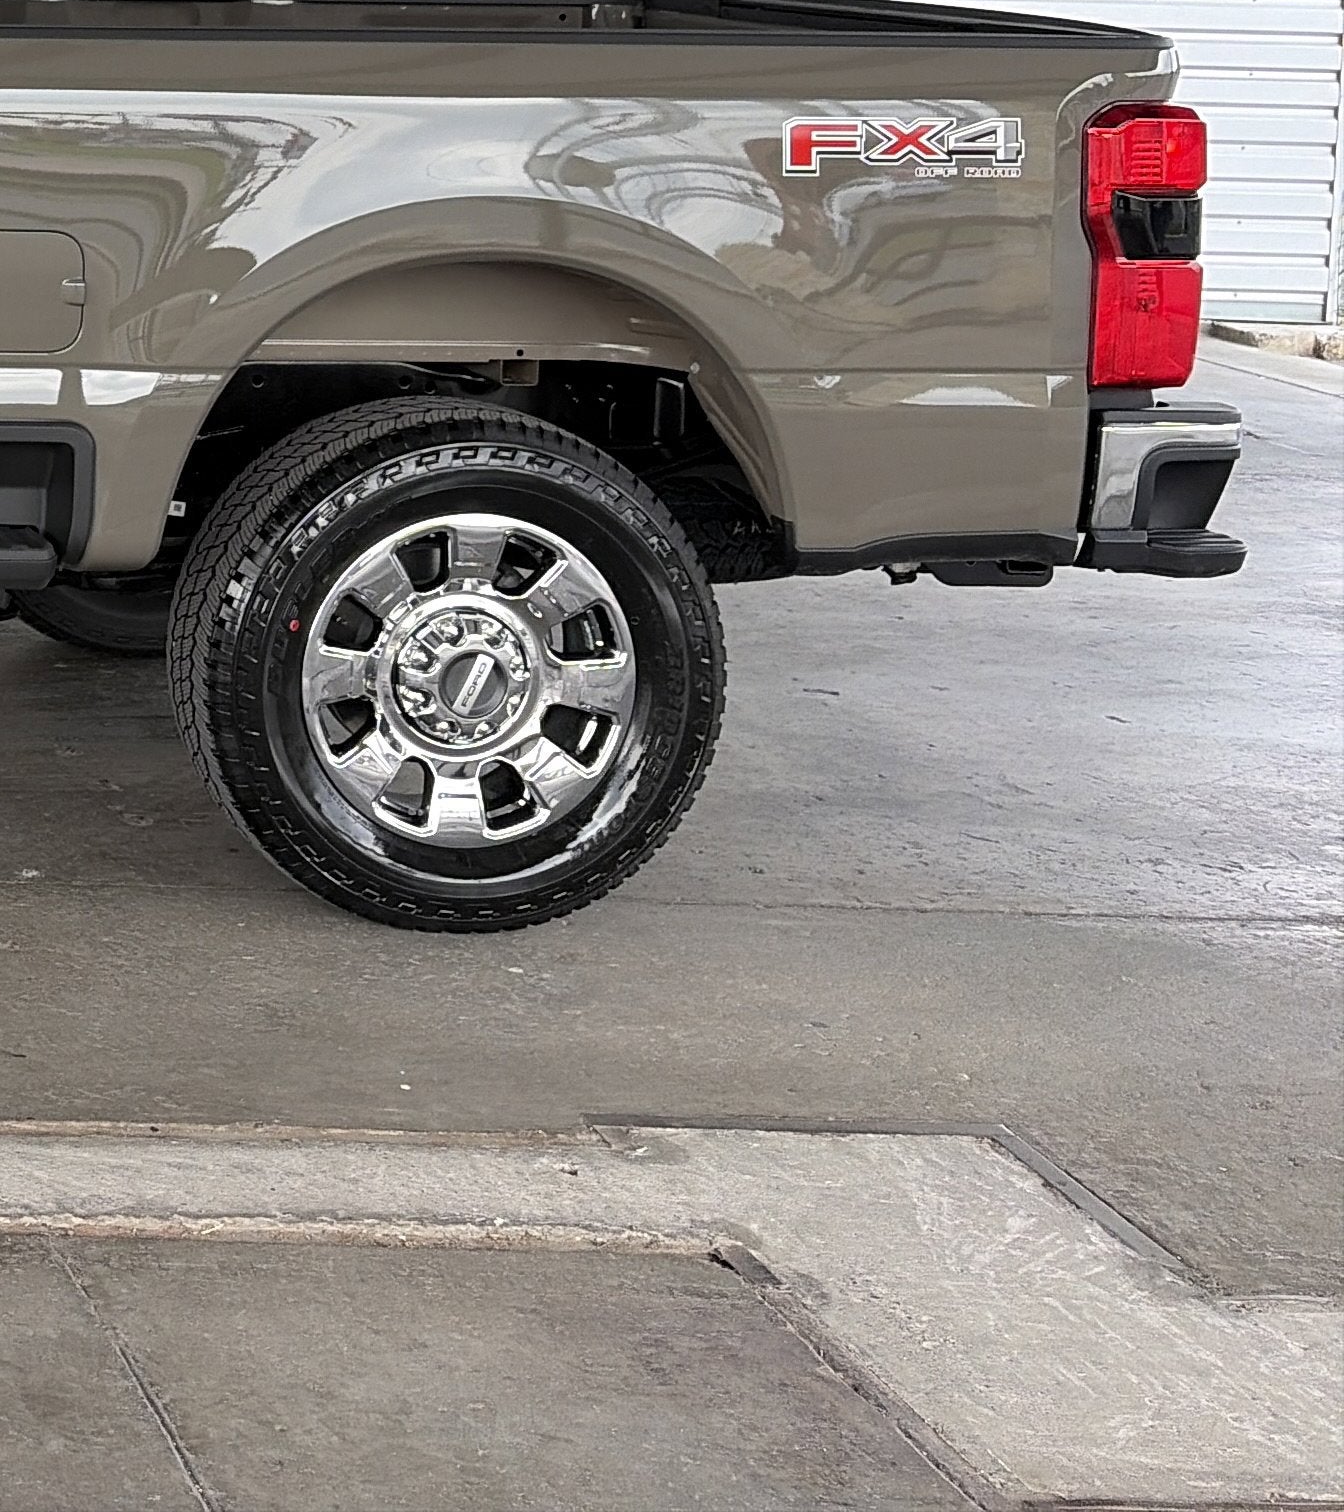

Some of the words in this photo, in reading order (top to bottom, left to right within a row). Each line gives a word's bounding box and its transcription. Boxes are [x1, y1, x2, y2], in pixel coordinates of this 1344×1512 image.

[783, 117, 1025, 176] FX4
[915, 166, 957, 178] OFF
[963, 166, 1022, 178] ROAD
[460, 662, 488, 707] FORD
